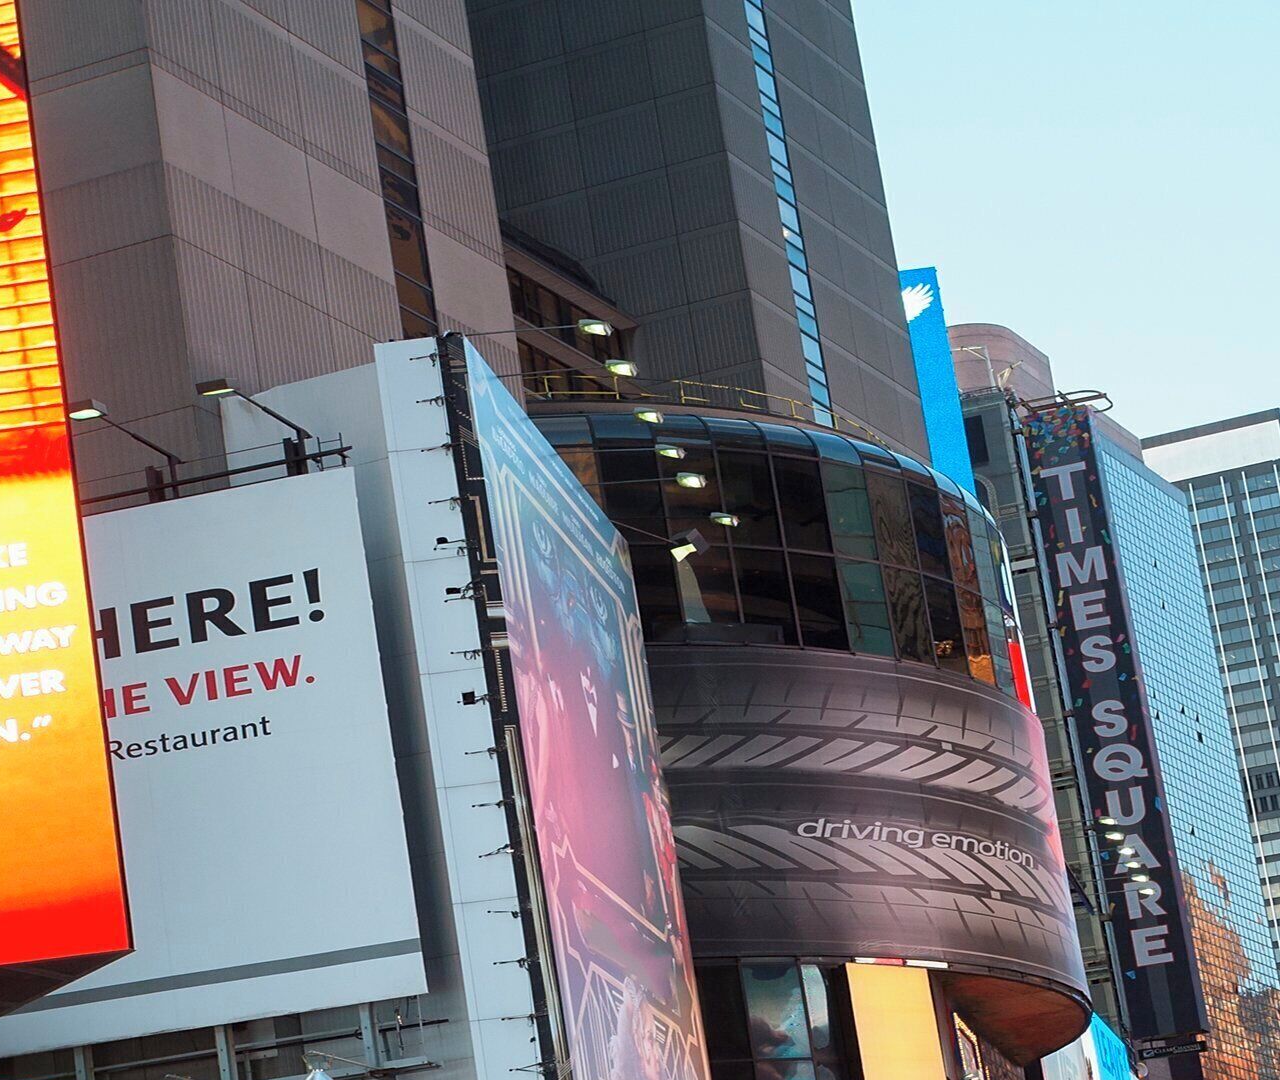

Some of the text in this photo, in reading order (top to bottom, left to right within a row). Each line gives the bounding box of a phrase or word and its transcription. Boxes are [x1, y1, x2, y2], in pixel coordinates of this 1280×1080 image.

[105, 654, 316, 718] HE VIEW.
[1040, 461, 1175, 967] TIMES SQUARE
[108, 716, 272, 761] Restaurant
[797, 818, 1035, 868] driving emotion
